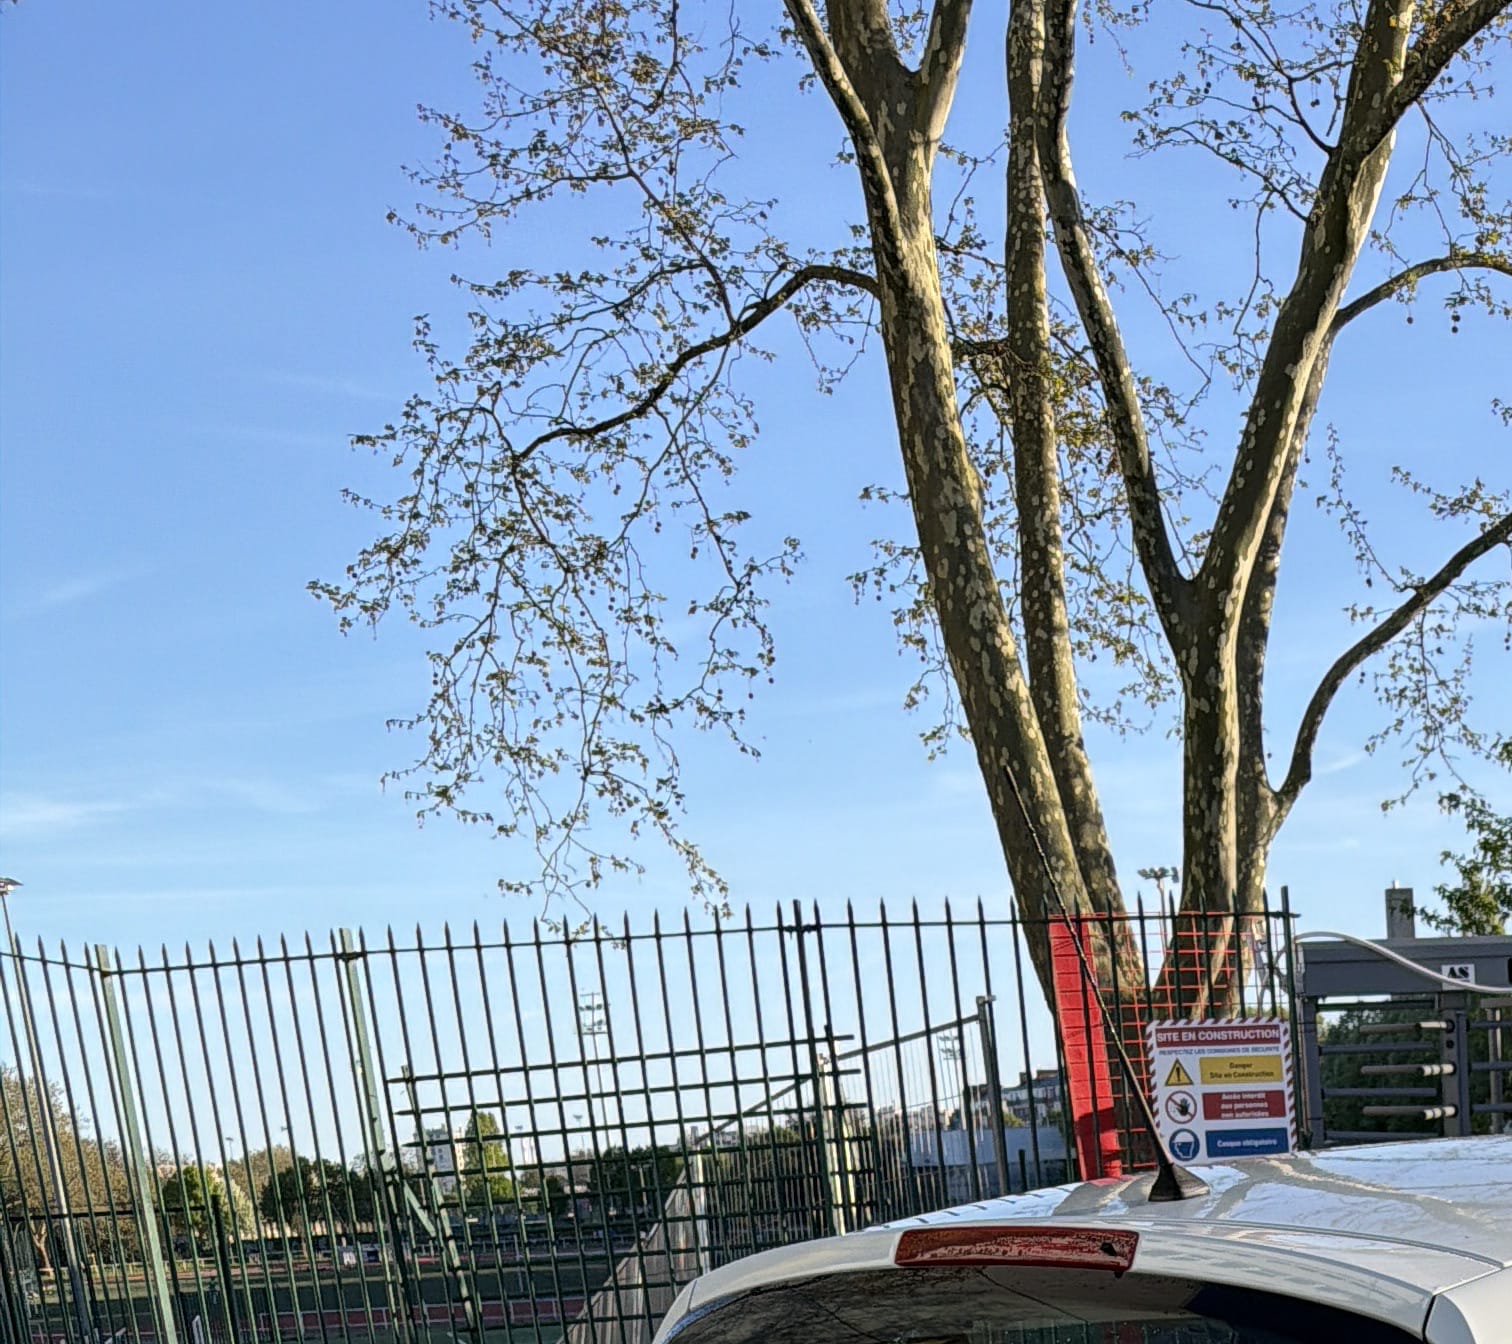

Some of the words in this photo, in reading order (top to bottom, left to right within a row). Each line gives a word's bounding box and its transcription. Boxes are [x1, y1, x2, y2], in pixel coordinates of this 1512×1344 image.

[1157, 1032, 1179, 1042] SITE
[1182, 1032, 1196, 1041] EN
[1198, 1029, 1280, 1040] CONSTRUCTION
[1229, 1062, 1253, 1070] Danger
[1233, 1070, 1274, 1078] Construction
[1234, 1101, 1268, 1111] personnes
[1243, 1138, 1277, 1149] obligatoire
